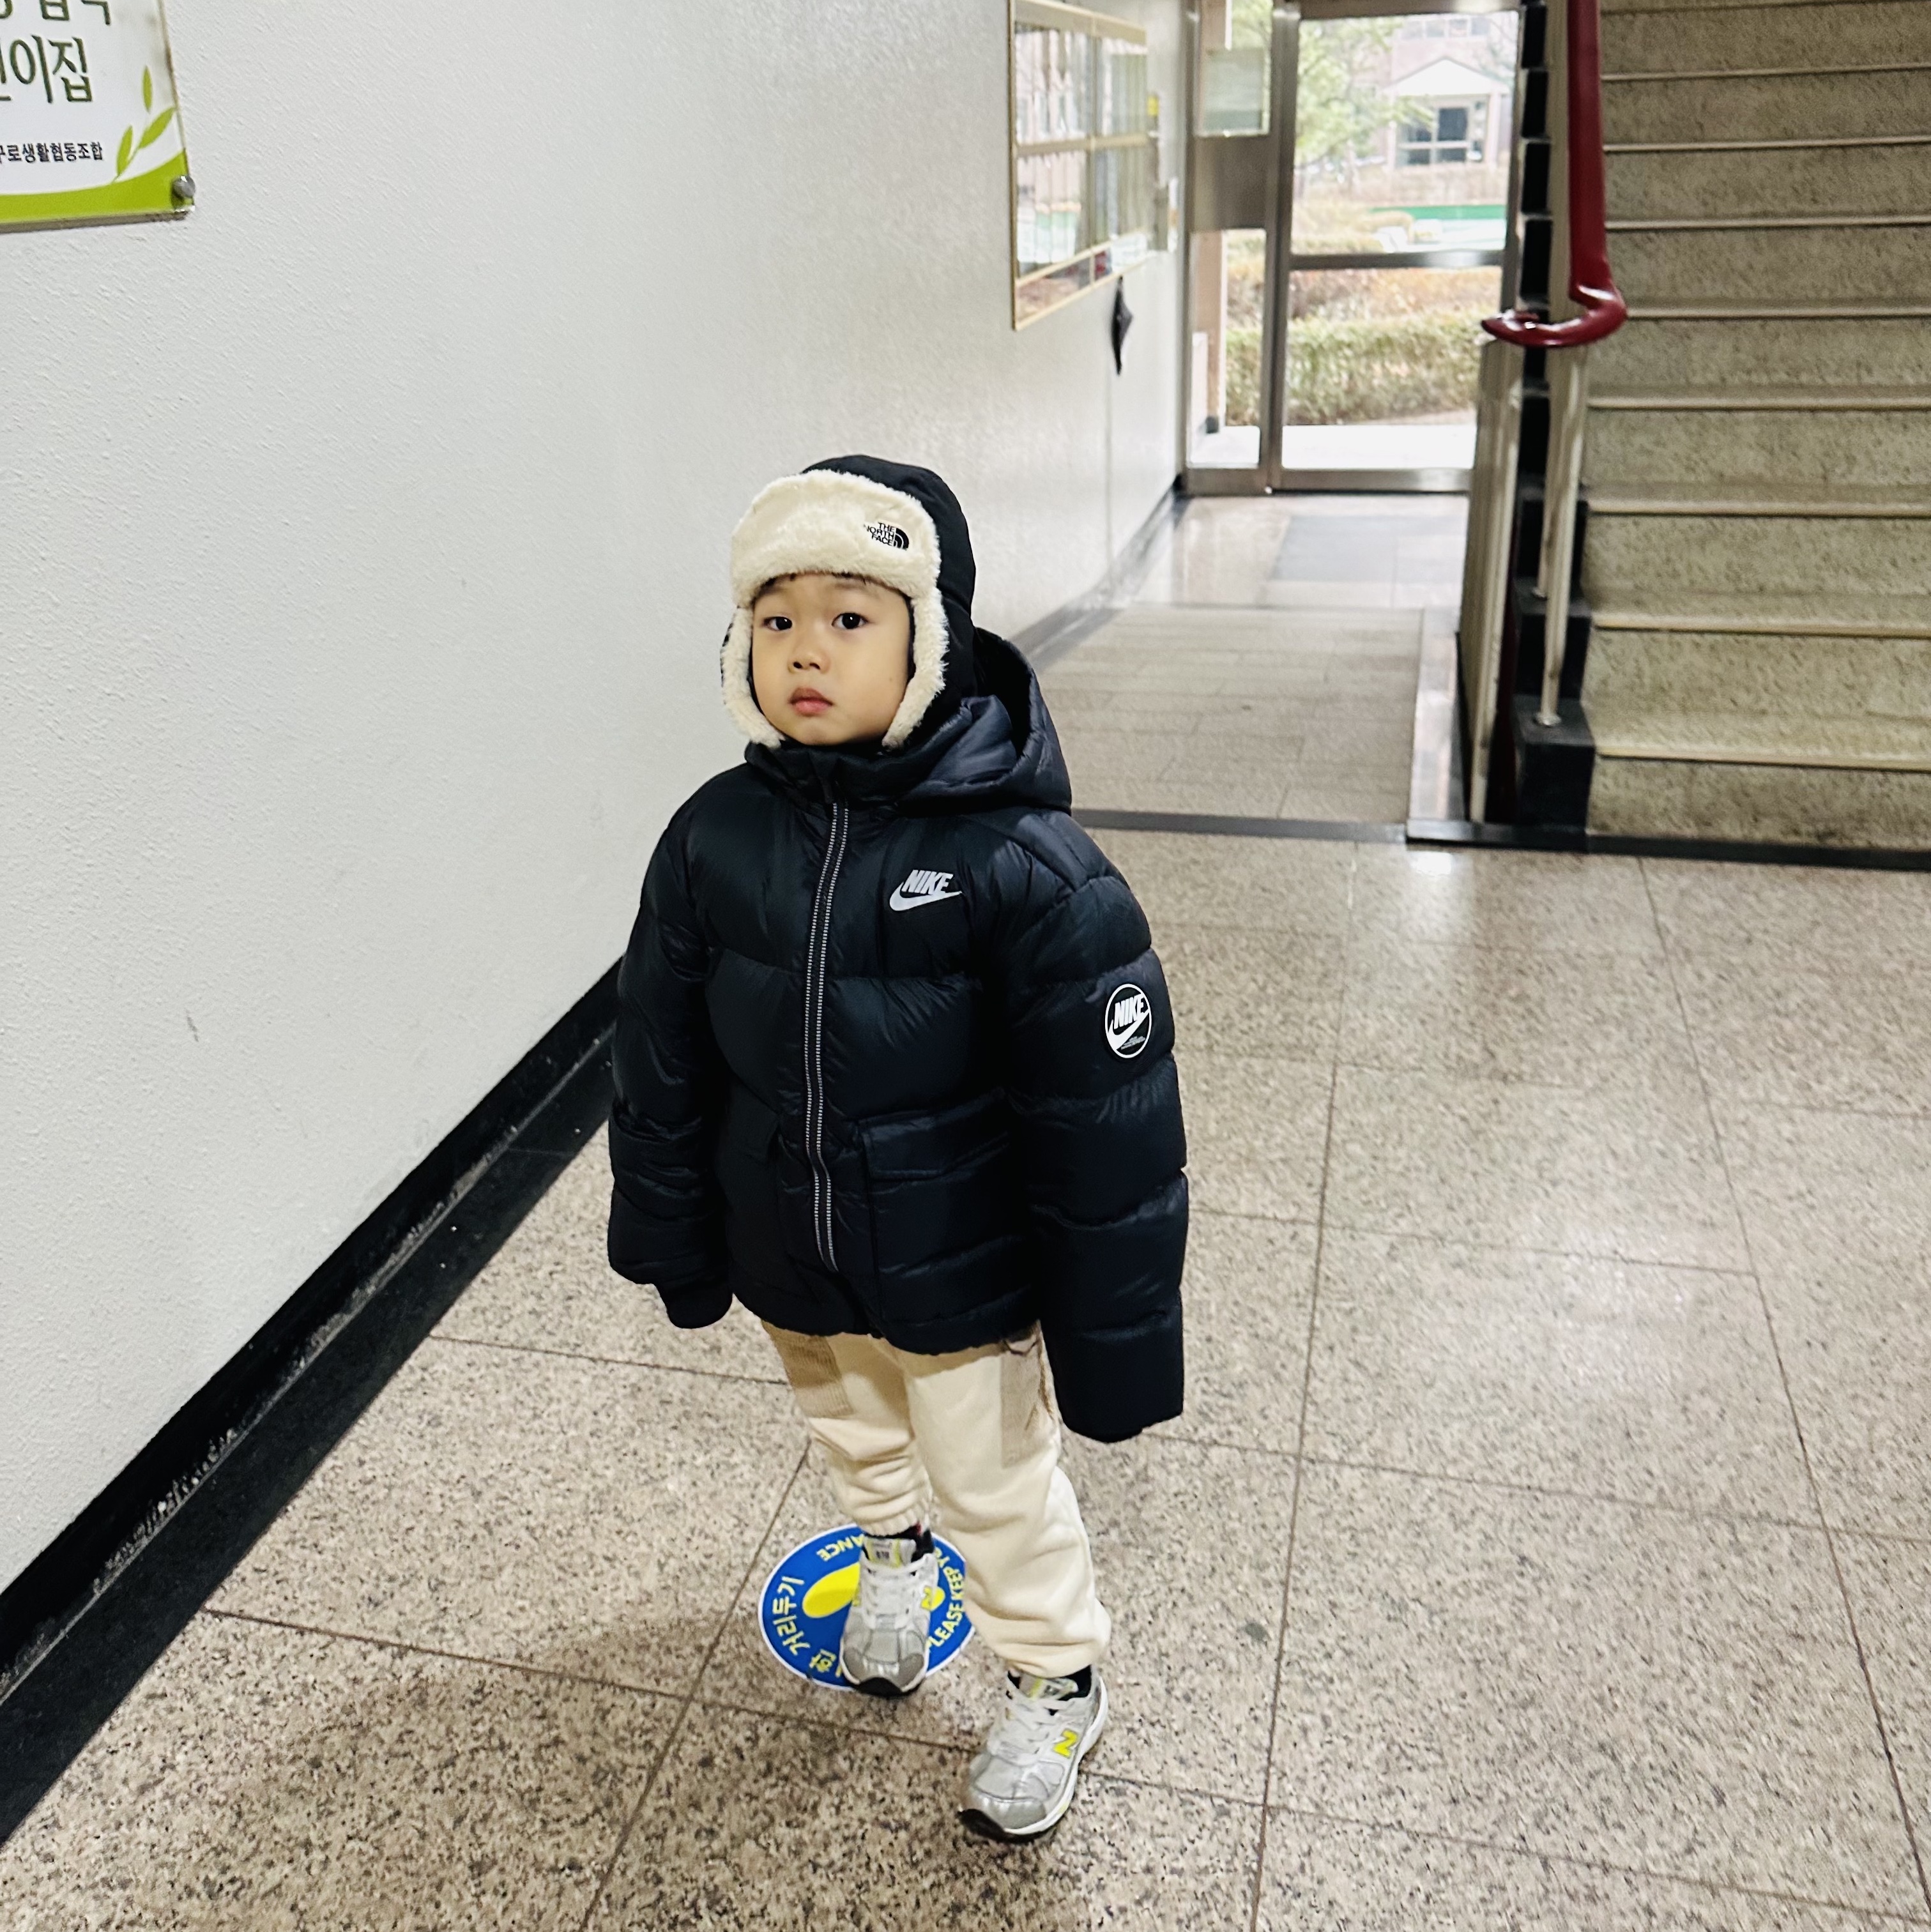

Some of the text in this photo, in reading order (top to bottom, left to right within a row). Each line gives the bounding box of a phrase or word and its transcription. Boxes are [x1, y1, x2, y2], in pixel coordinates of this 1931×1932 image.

[871, 534, 894, 547] FACE
[878, 522, 896, 533] THE
[901, 869, 954, 895] NIKE
[1113, 993, 1145, 1030] NIKE
[816, 1533, 865, 1562] ANCE
[943, 1567, 963, 1600] KEEP
[772, 1576, 811, 1656] 거리두기
